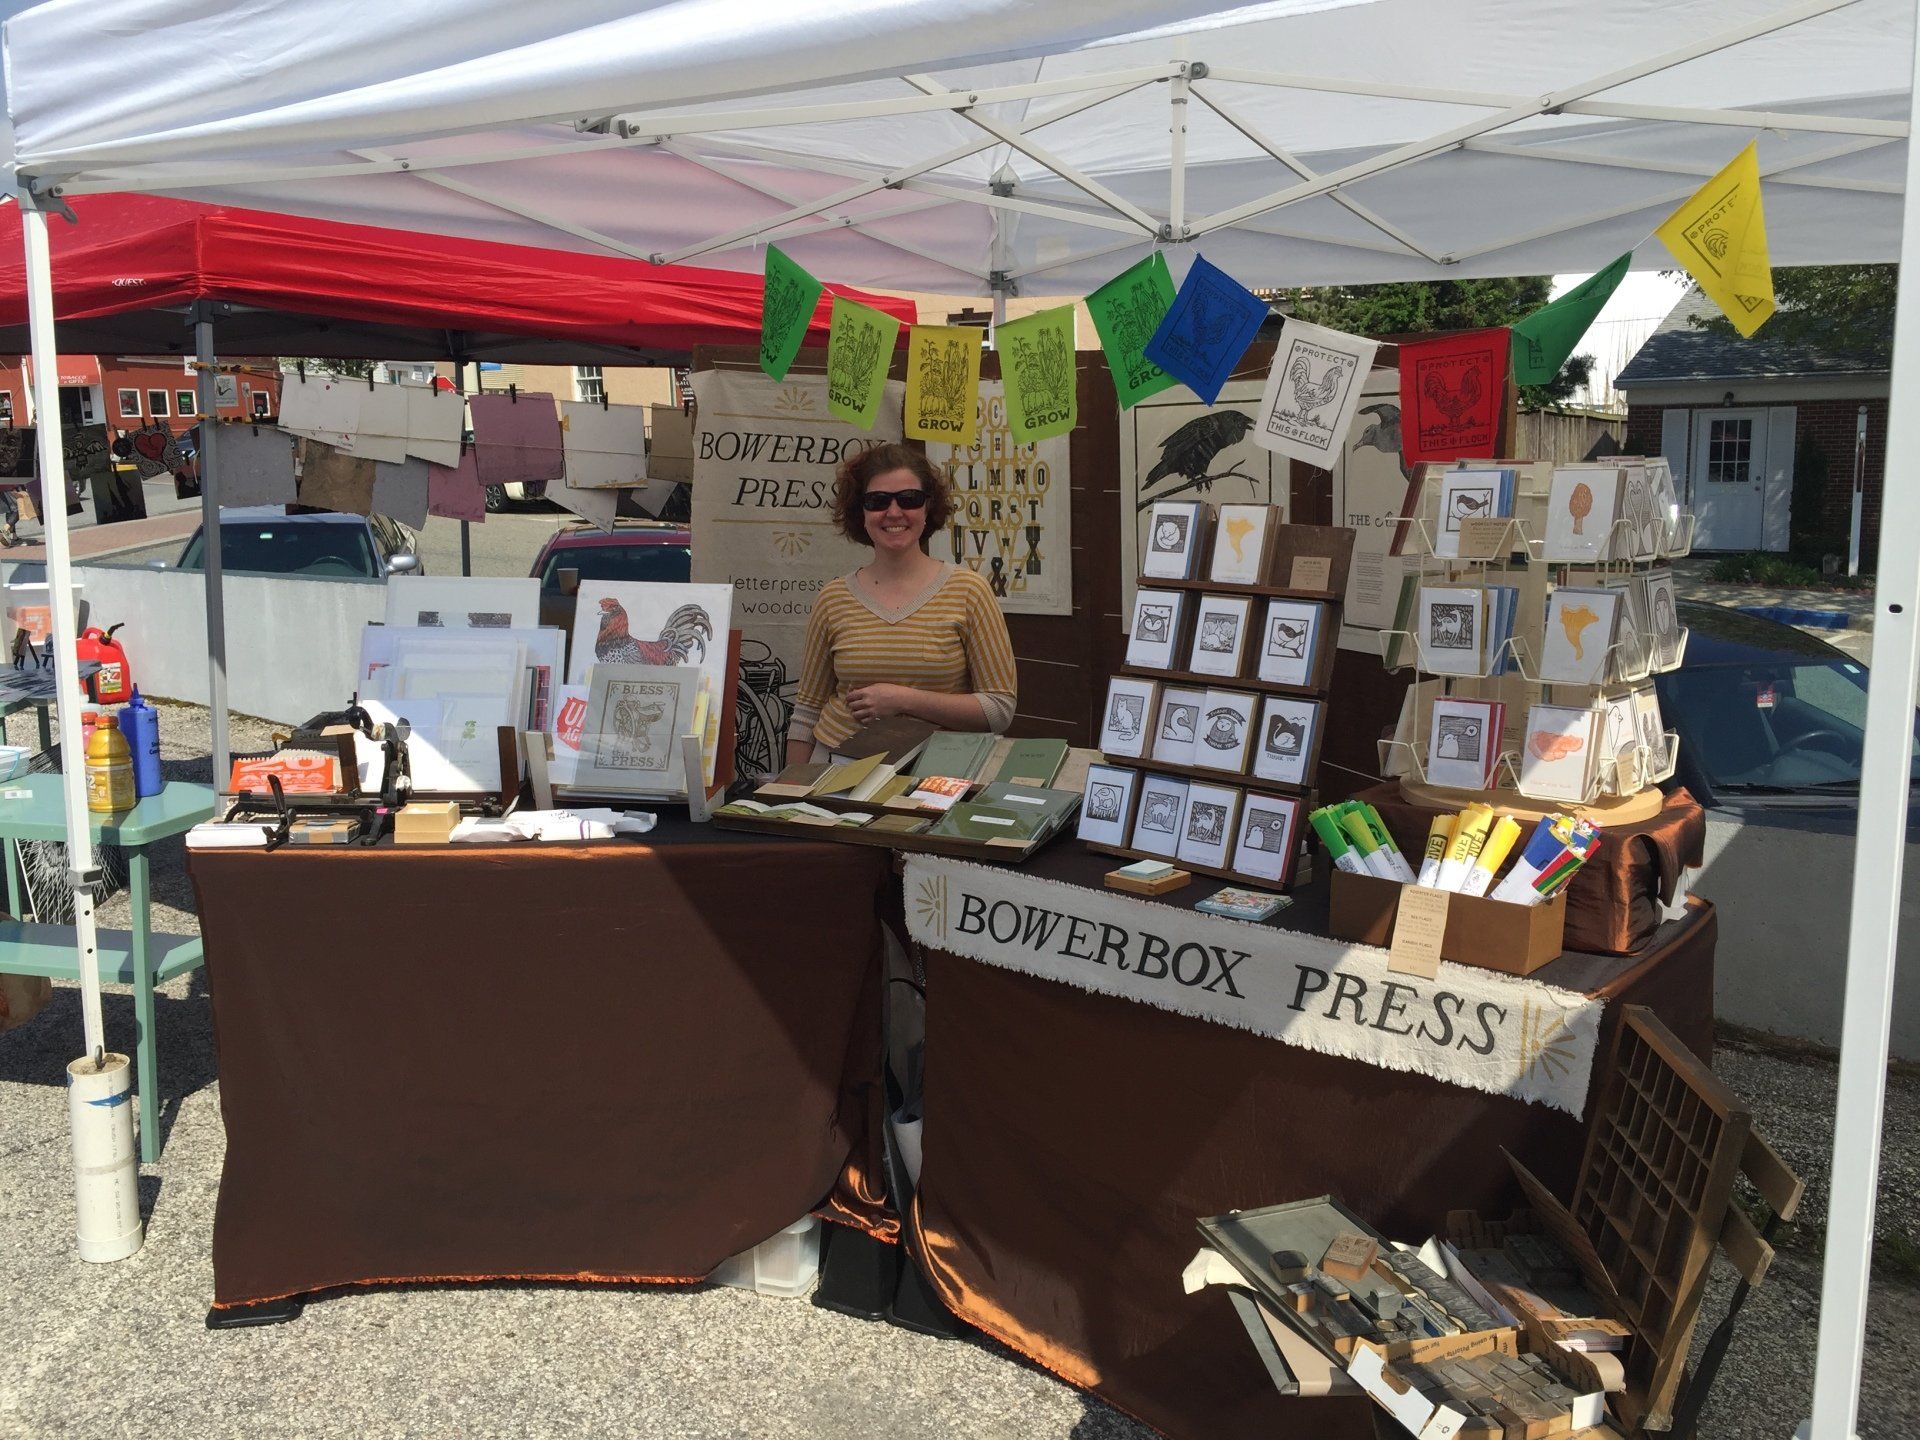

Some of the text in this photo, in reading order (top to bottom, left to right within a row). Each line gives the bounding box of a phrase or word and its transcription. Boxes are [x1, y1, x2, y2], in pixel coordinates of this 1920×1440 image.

[1698, 194, 1738, 233] PROTE
[1301, 348, 1348, 366] PROTECT
[1428, 356, 1480, 371] PROTECT
[1129, 366, 1163, 390] GRO
[828, 389, 866, 413] GROW
[918, 418, 964, 432] GROW
[1025, 407, 1070, 430] GROW
[1270, 421, 1328, 446] THIS FLOCK
[1423, 438, 1447, 449] THIS
[1349, 514, 1371, 526] THE
[741, 601, 812, 615] woodcu
[622, 685, 664, 695] BLESS
[611, 756, 654, 767] PRESS
[955, 893, 1507, 1055] BOWERBOX PRESS
